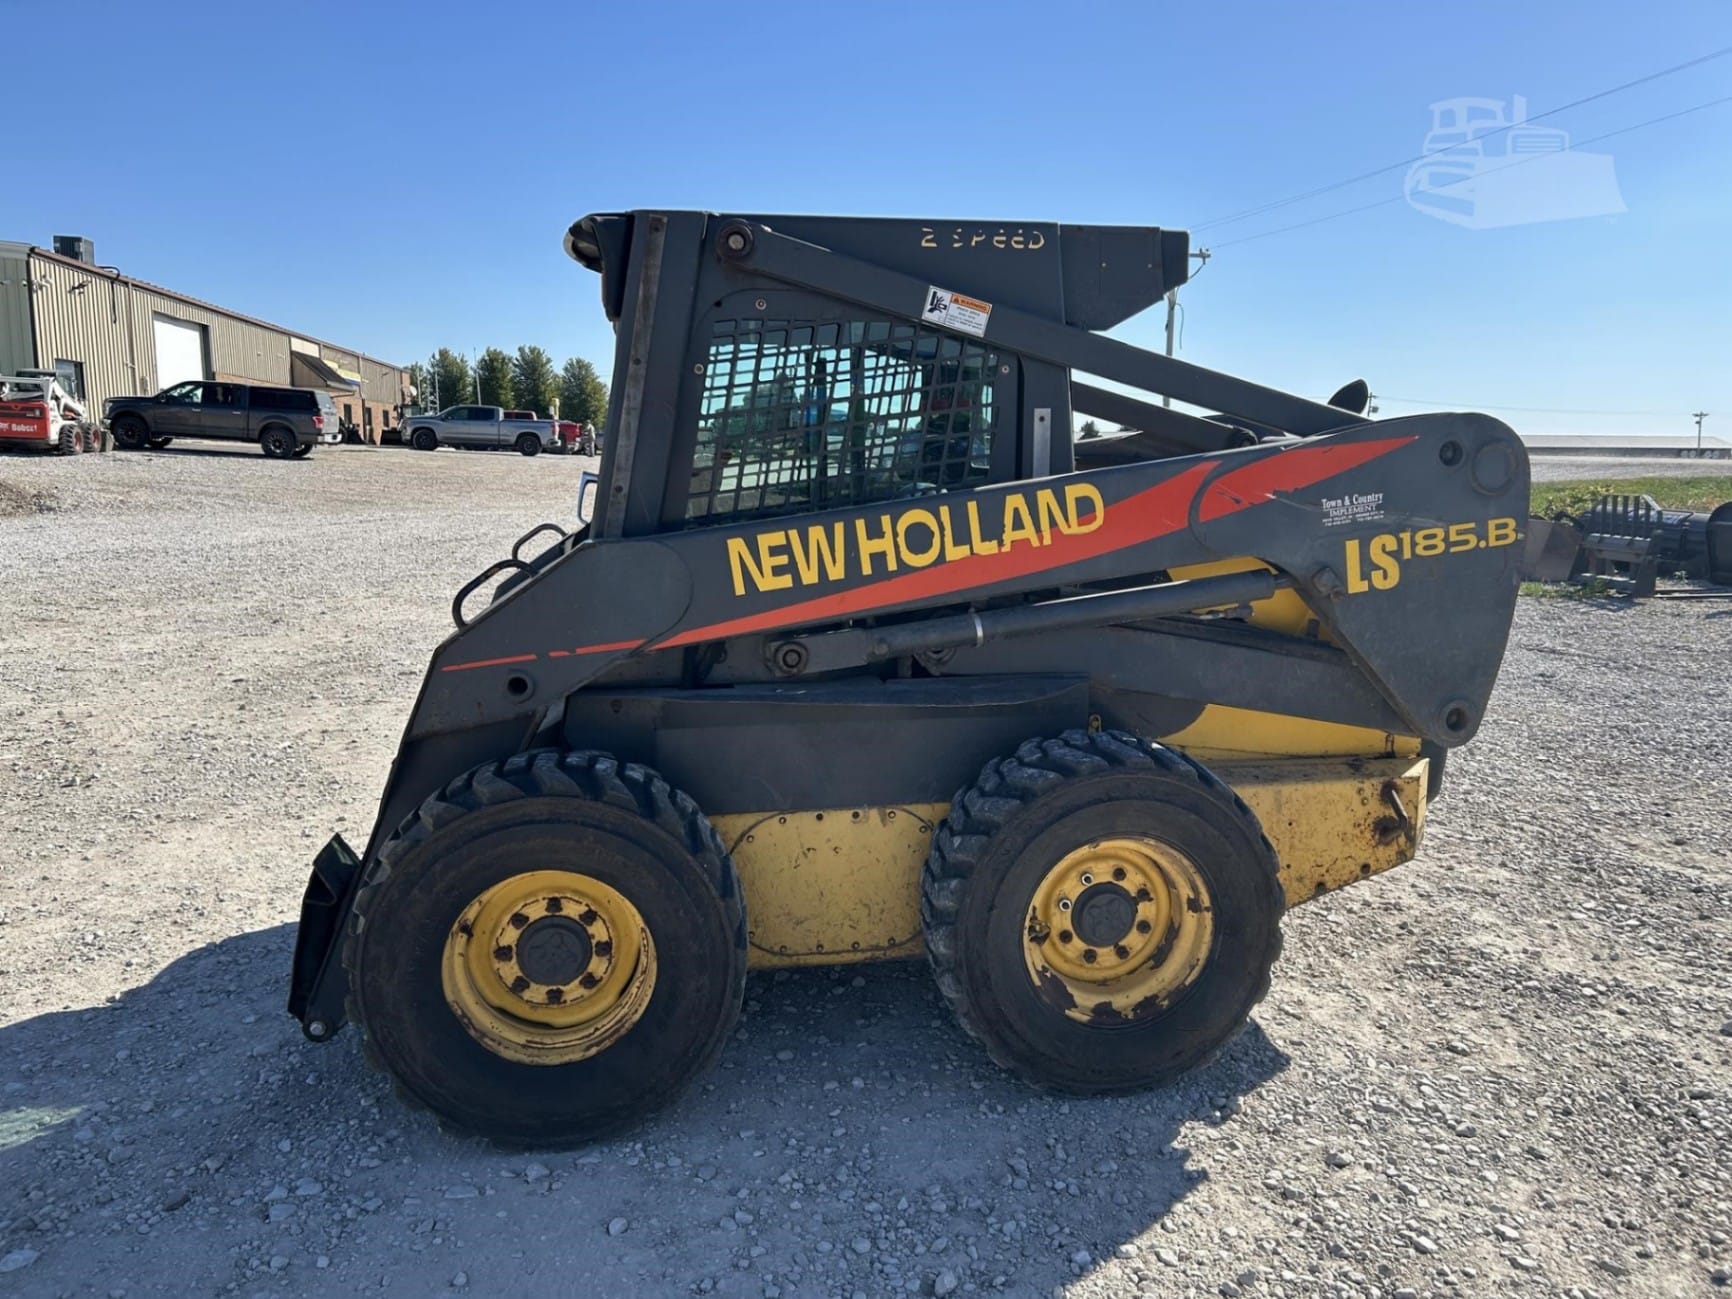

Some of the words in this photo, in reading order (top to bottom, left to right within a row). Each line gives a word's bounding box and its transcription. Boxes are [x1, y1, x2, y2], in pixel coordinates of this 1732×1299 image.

[920, 227, 938, 248] 2
[952, 227, 1046, 249] SPEED
[1321, 497, 1343, 509] Town
[1343, 495, 1351, 506] &
[1352, 492, 1384, 505] Country
[1329, 503, 1377, 518] IMPLEMENT
[726, 521, 845, 596] NEW
[855, 482, 1105, 576] HOLLAND
